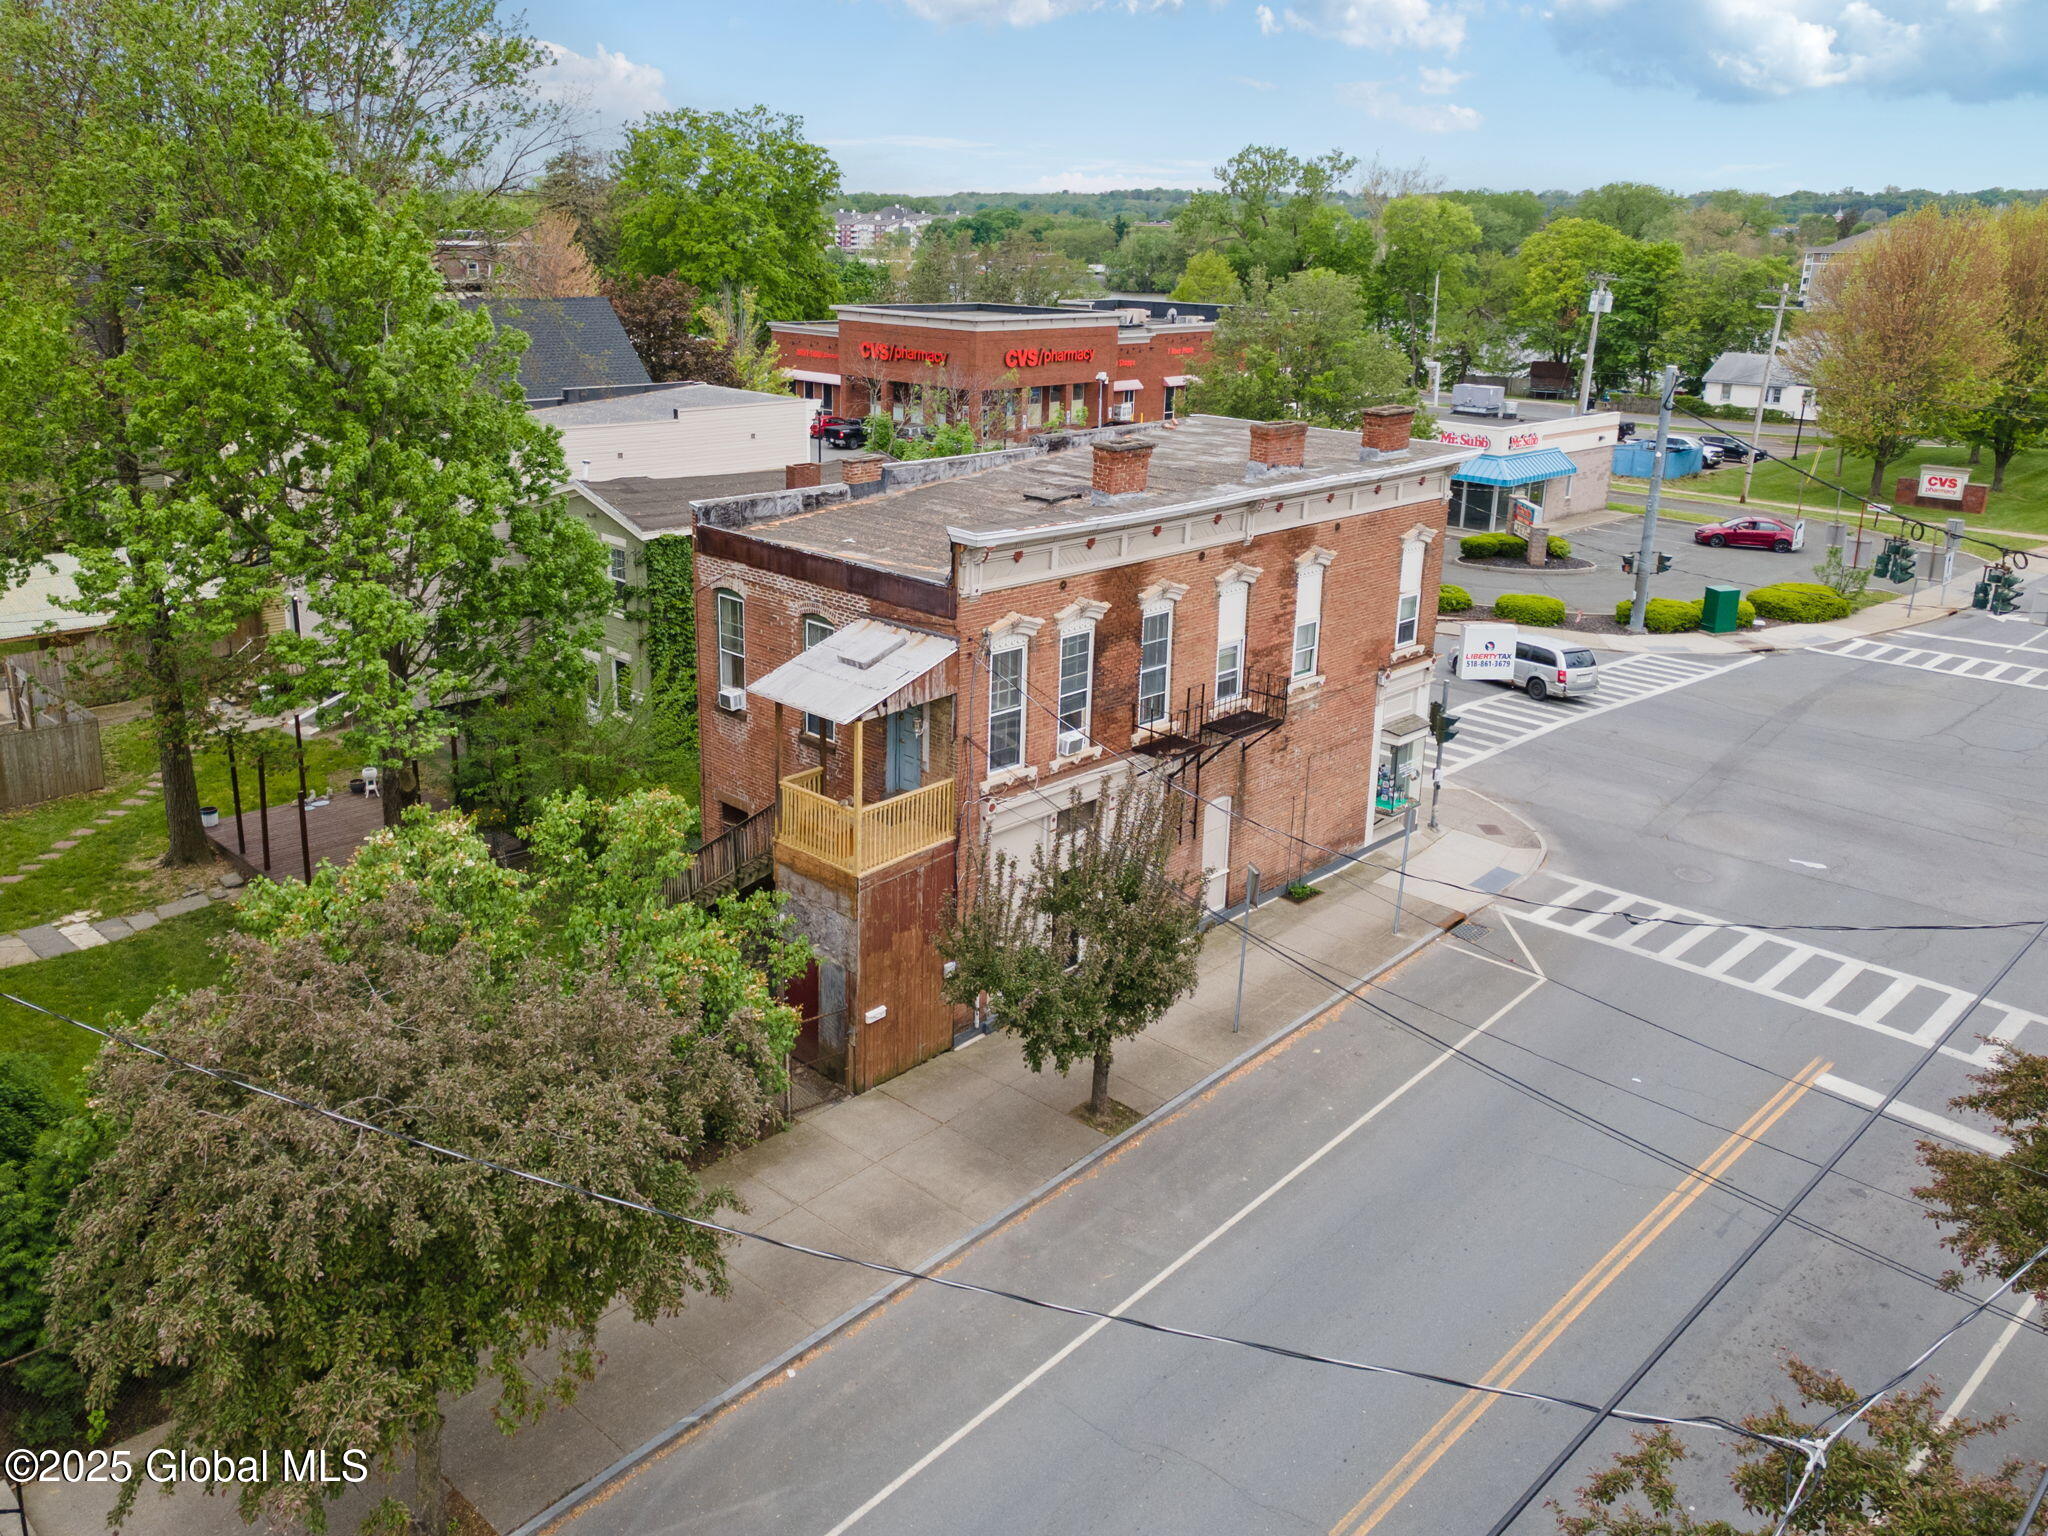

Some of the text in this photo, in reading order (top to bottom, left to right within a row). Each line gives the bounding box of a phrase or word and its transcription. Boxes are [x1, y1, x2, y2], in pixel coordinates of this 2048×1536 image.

[859, 341, 949, 366] CVS/pharmacy
[1005, 347, 1095, 368] CVS/pharmacy
[1440, 431, 1489, 448] Mr. Subb
[1928, 476, 1958, 489] CVS
